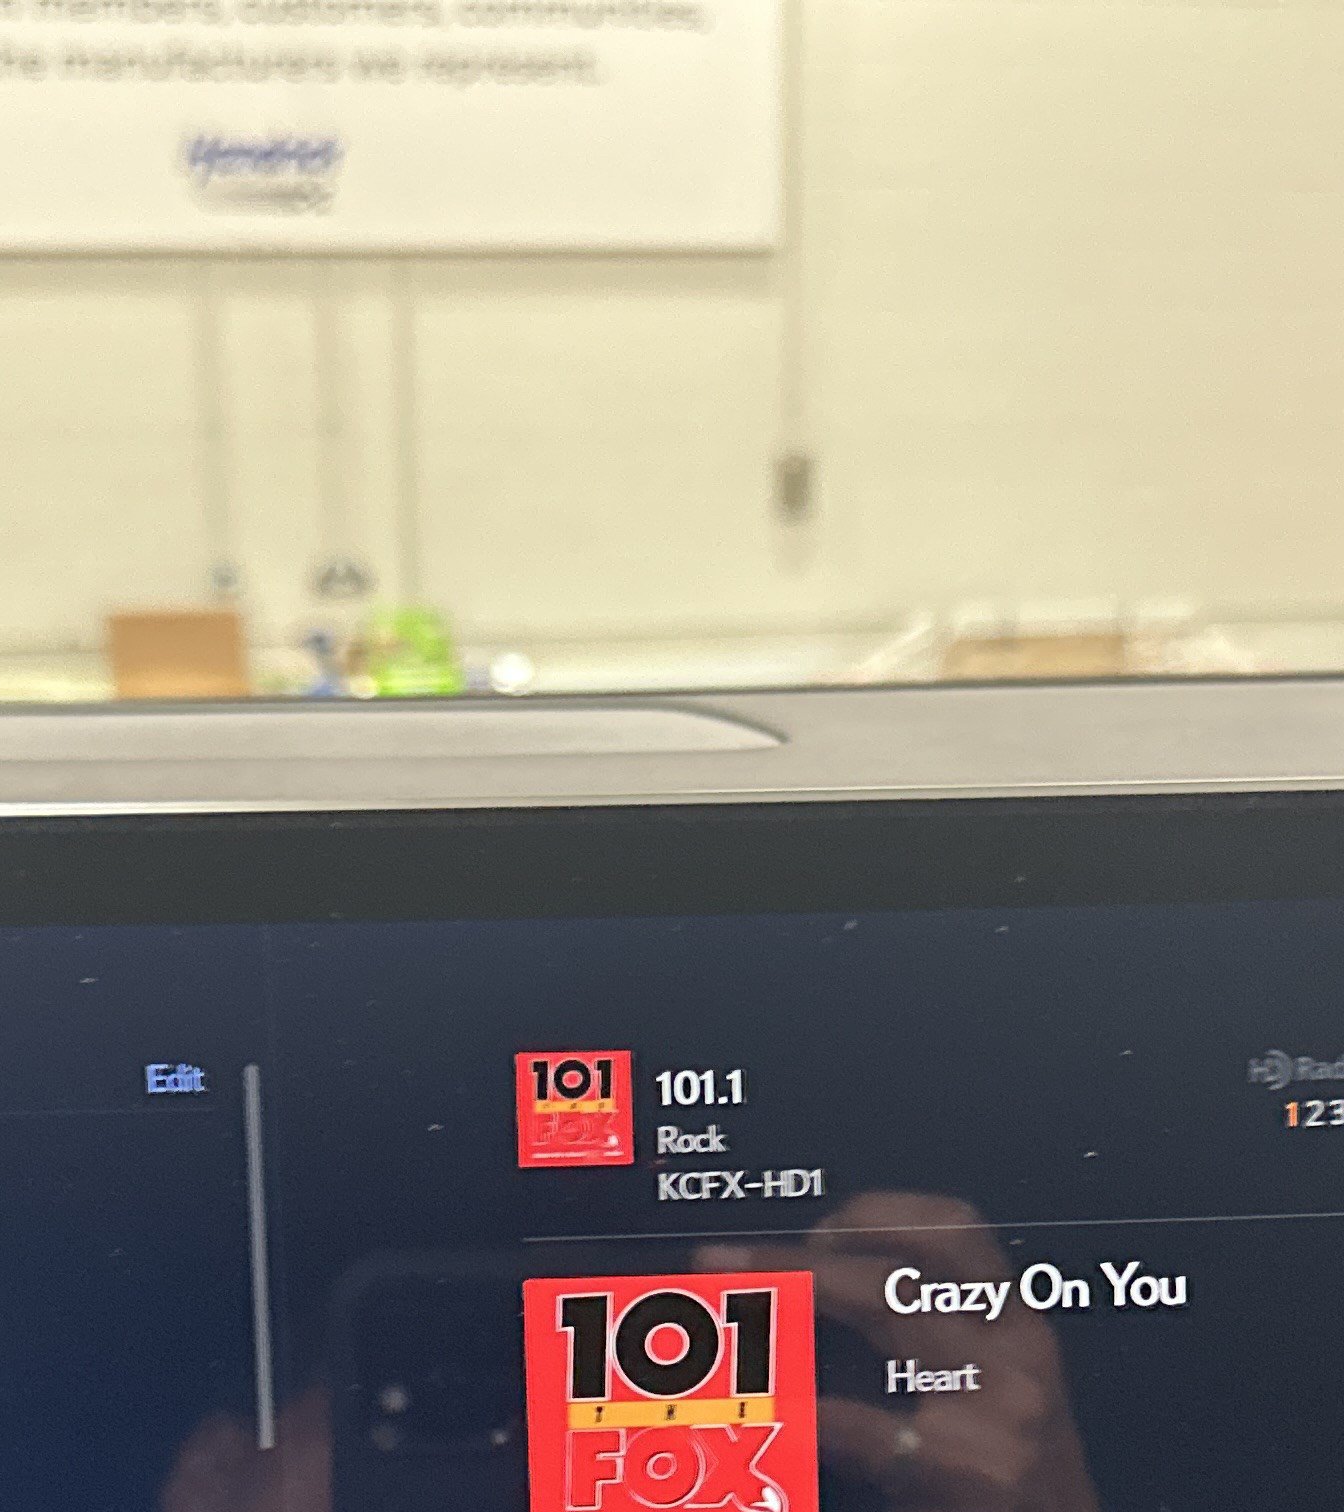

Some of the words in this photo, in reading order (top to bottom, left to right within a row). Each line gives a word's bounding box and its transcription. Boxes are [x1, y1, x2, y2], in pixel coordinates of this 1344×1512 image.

[145, 1062, 207, 1096] Edit
[532, 1058, 613, 1101] 101
[656, 1068, 744, 1107] 101.1
[657, 1123, 727, 1154] Rock
[657, 1168, 824, 1201] KCFX-HD1
[883, 1266, 1011, 1320] Crazy
[1019, 1264, 1090, 1310] On
[1101, 1261, 1188, 1308] You
[555, 1287, 779, 1403] 101
[886, 1359, 981, 1394] Heart
